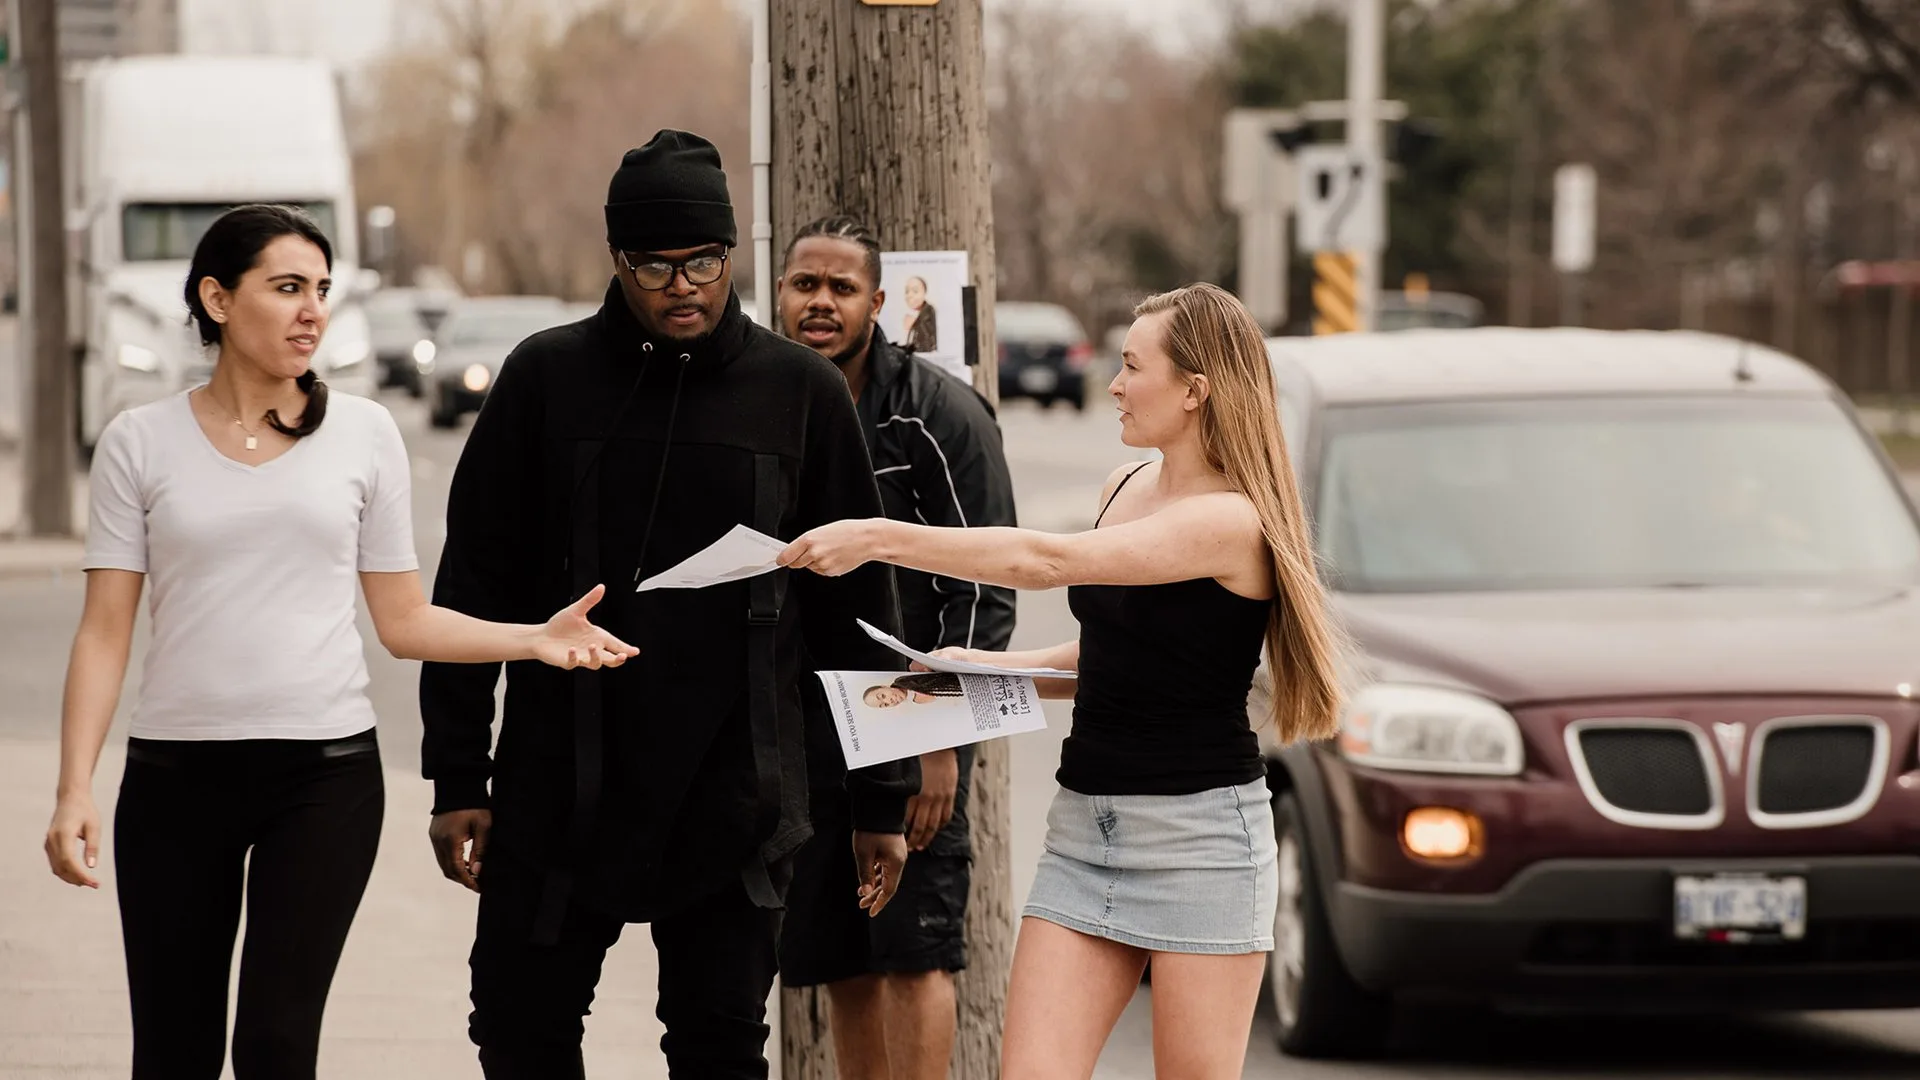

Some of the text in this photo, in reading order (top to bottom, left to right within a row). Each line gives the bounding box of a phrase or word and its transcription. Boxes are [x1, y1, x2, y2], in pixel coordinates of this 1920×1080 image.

[841, 698, 850, 710] THIS
[846, 709, 854, 725] SEEN
[848, 725, 857, 737] YOU
[851, 738, 860, 752] HAVE
